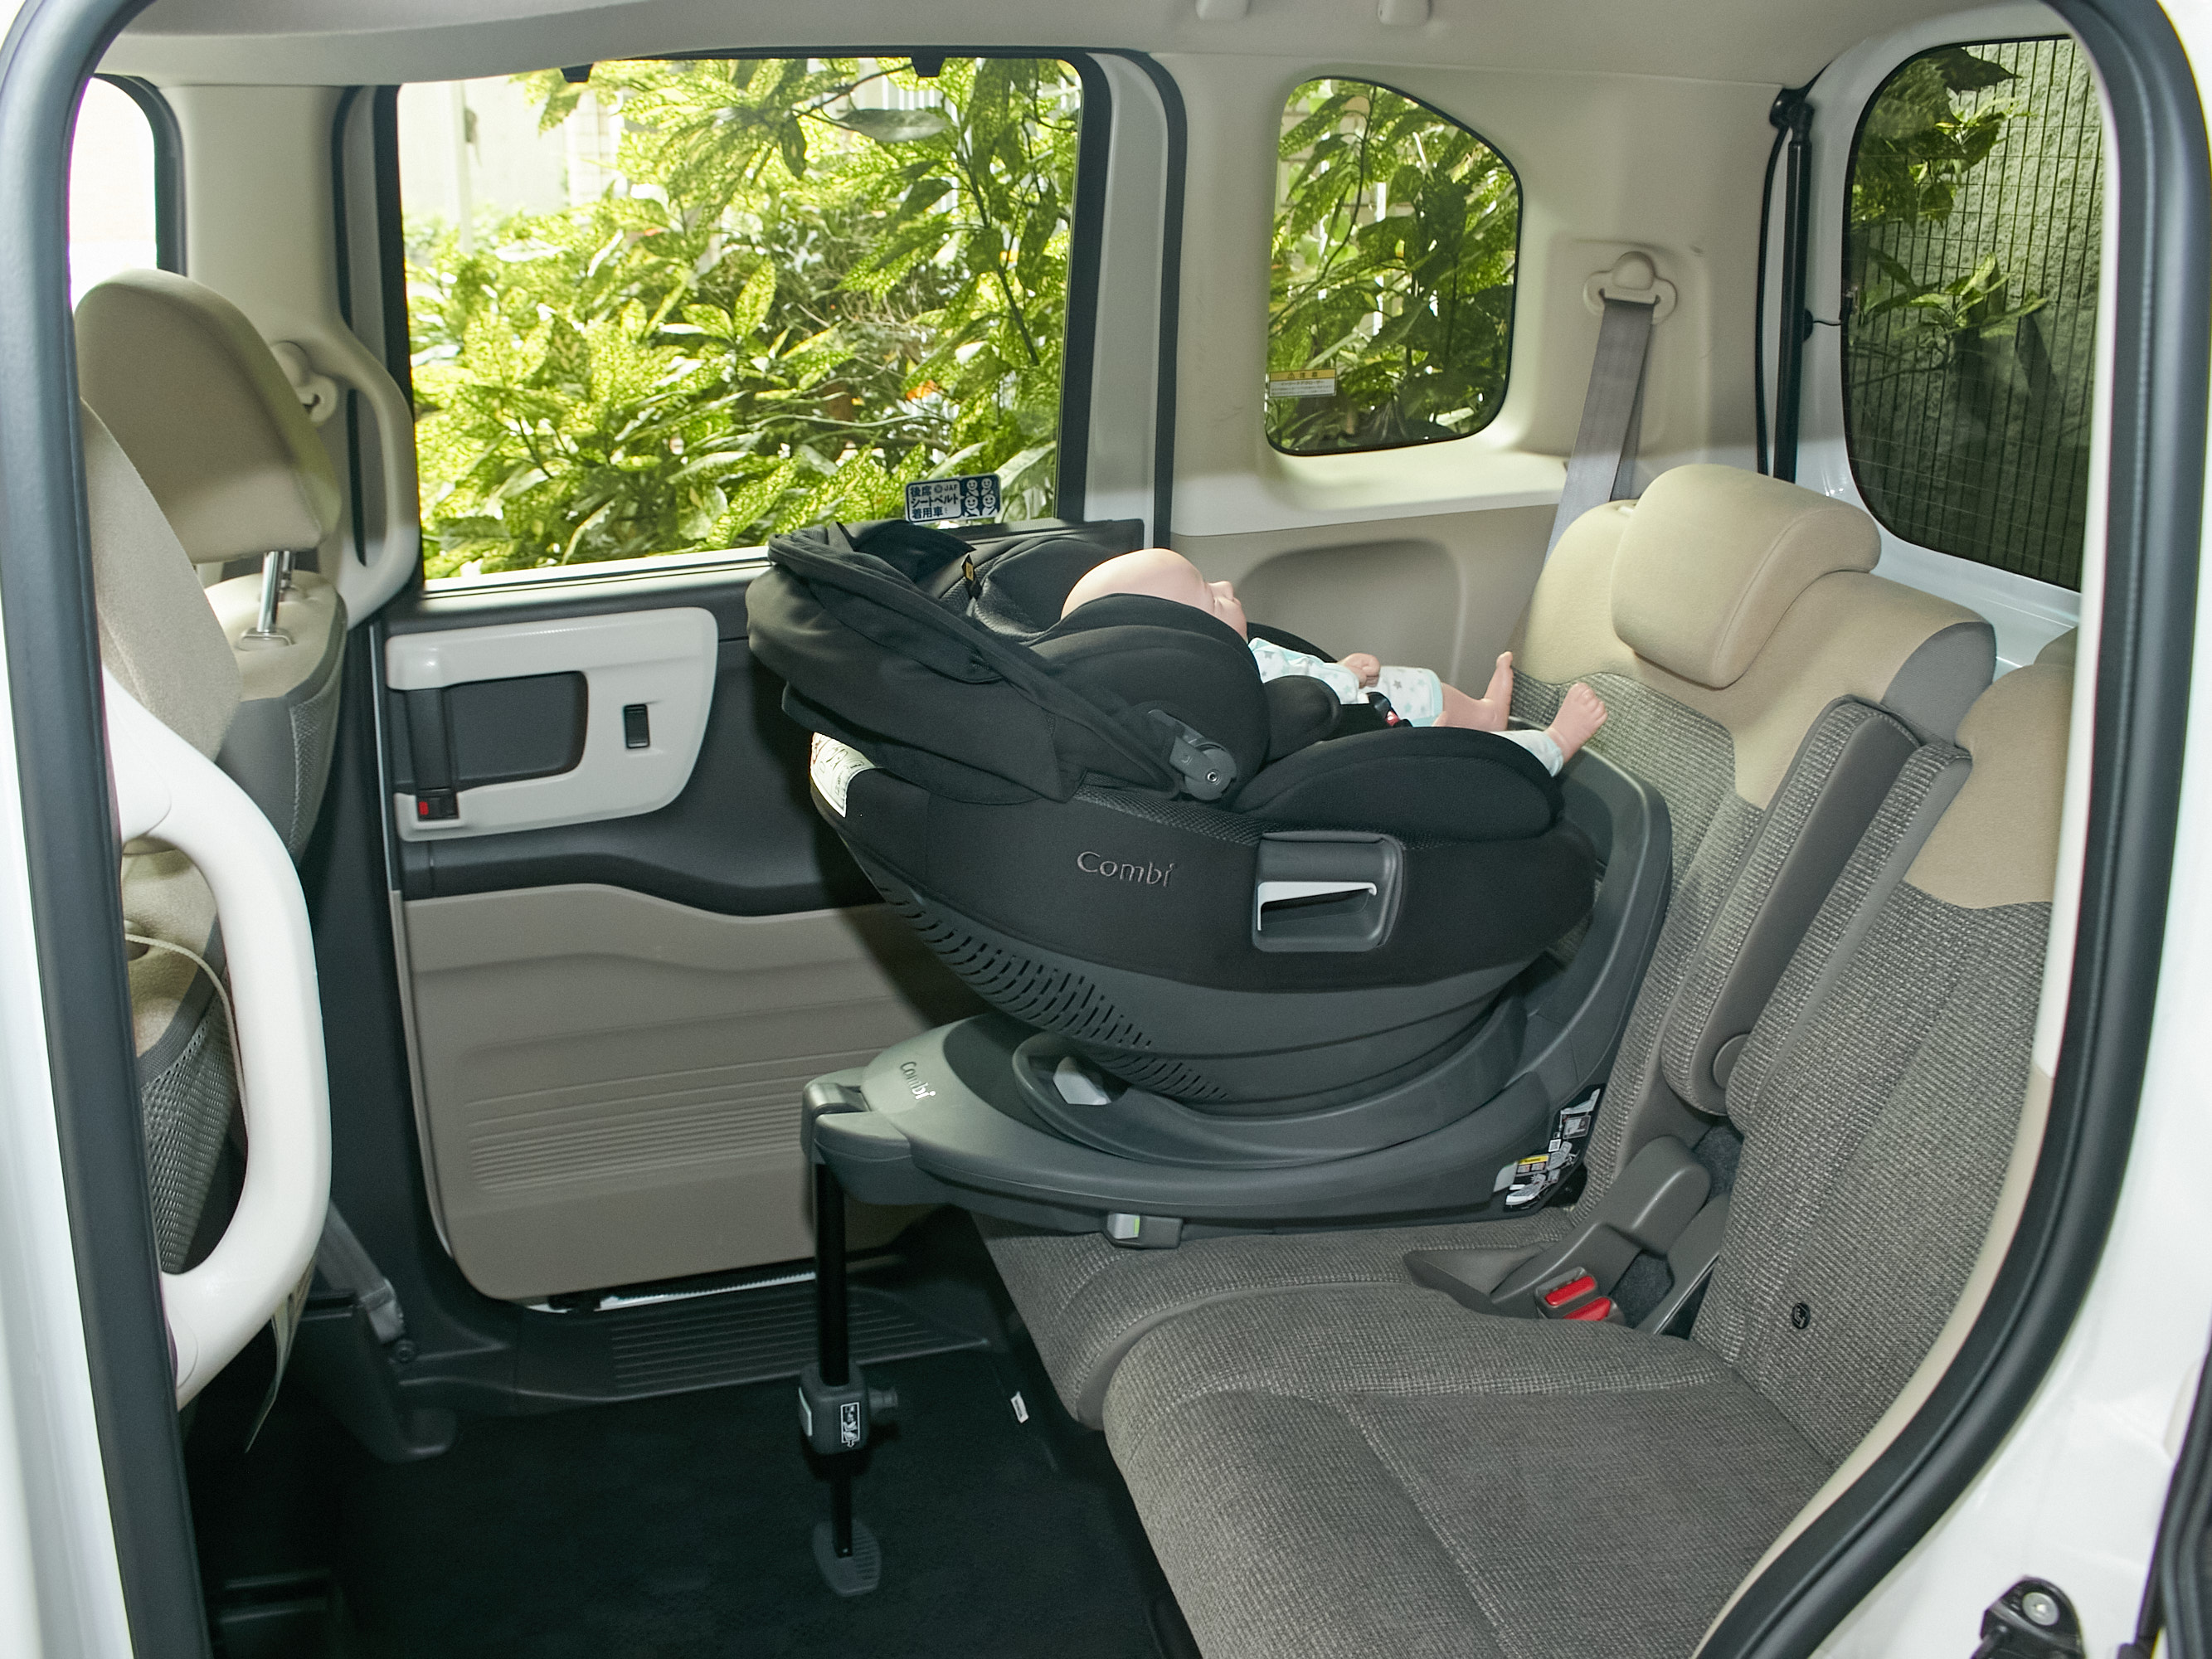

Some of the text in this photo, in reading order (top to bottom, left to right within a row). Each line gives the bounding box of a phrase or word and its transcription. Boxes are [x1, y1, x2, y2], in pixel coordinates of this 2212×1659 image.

[911, 494, 959, 508] シートベルト
[912, 506, 943, 519] 着用車
[1077, 851, 1174, 887] Combi
[900, 1062, 936, 1100] Combi
